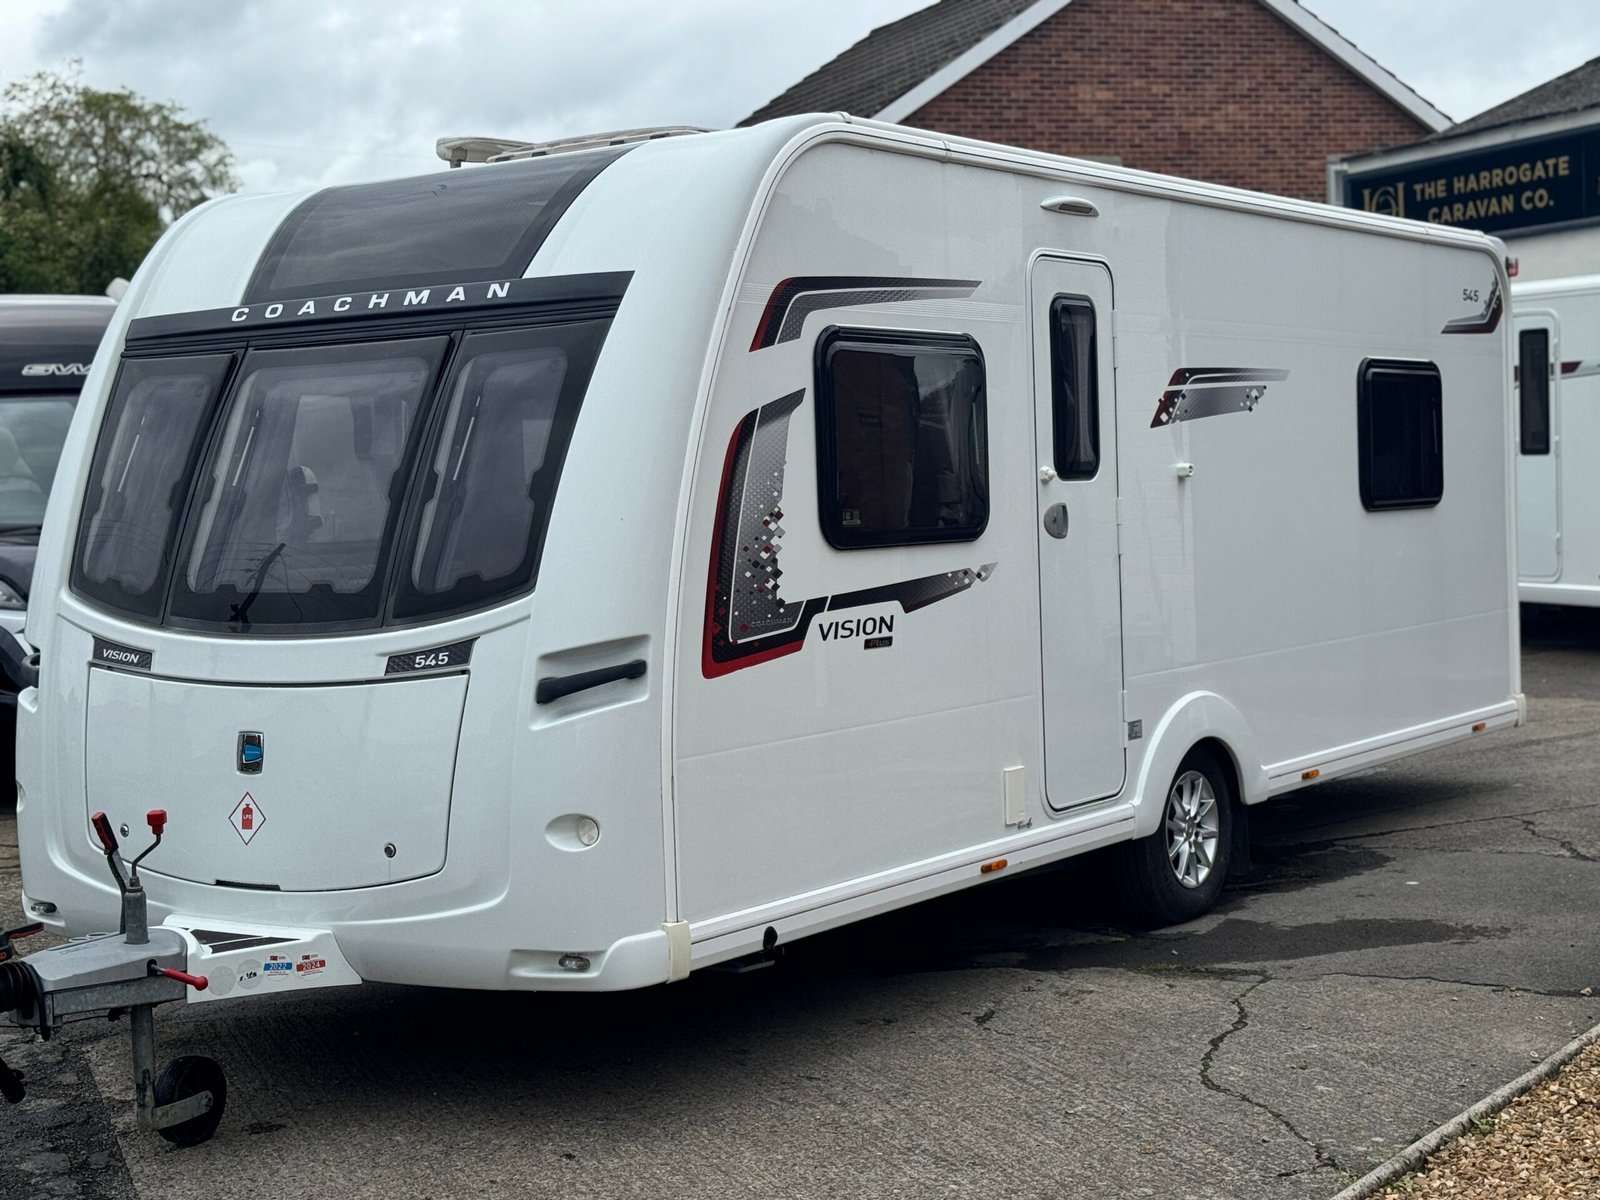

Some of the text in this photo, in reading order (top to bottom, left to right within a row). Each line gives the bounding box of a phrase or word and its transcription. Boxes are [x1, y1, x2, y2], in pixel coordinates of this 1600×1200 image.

[1413, 178, 1447, 201] THE
[1453, 155, 1570, 195] HARROGATE
[1428, 194, 1514, 224] CARAVAN
[1520, 188, 1554, 210] CO.
[231, 281, 511, 322] COACHMAN
[1462, 288, 1479, 303] 545
[818, 614, 894, 642] VISION
[103, 648, 140, 664] VISION
[414, 652, 449, 669] 545
[270, 962, 288, 970] 2022
[303, 960, 320, 970] 2024
